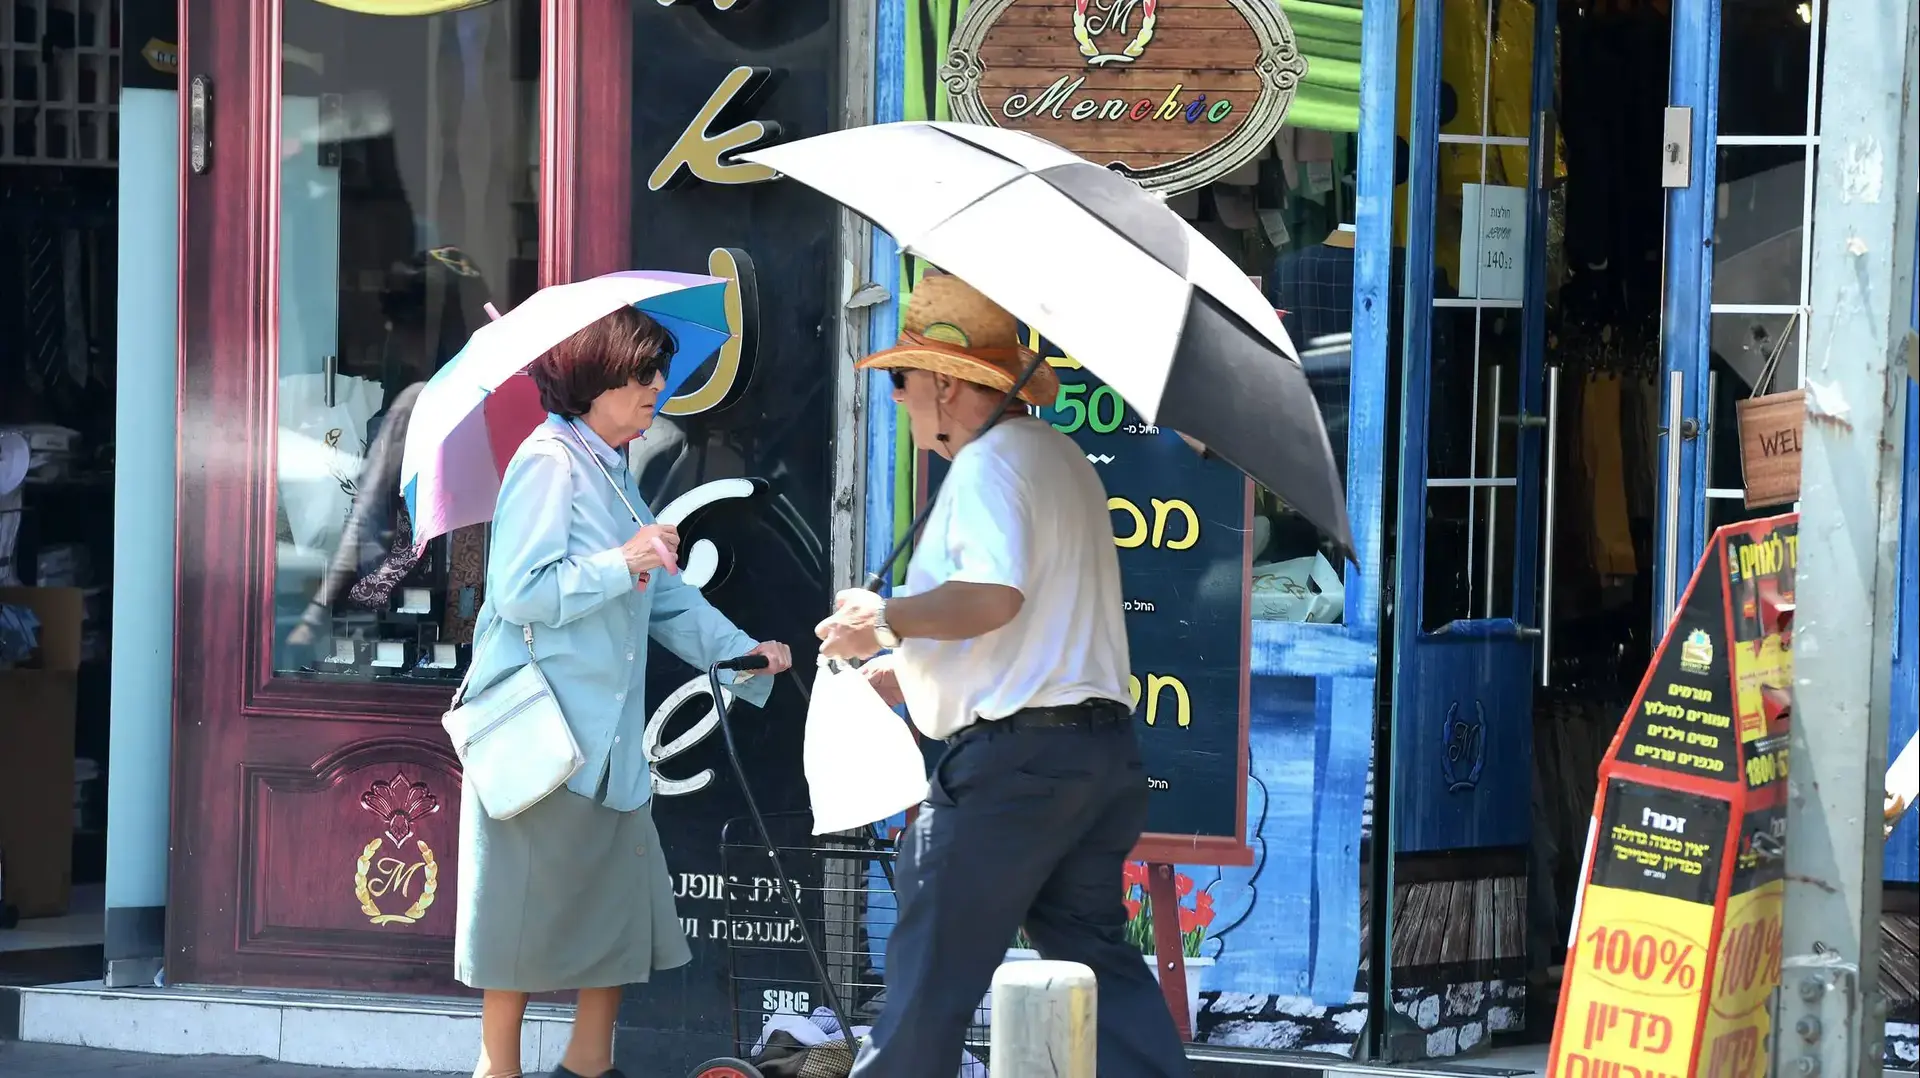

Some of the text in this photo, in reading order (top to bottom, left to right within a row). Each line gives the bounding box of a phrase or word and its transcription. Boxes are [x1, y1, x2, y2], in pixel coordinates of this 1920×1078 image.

[1003, 75, 1233, 123] Menchic
[1052, 384, 1125, 433] 50
[1134, 600, 1155, 611] החל
[1668, 684, 1712, 702] תורמים
[1644, 701, 1685, 719] לחילוץ
[1647, 724, 1719, 748] נשים וילדים
[1634, 744, 1724, 772] מכפרים ערביים
[1147, 777, 1169, 789] החל
[368, 857, 425, 898] M
[1587, 925, 1696, 990] 100%
[1583, 1001, 1674, 1054] פדיון
